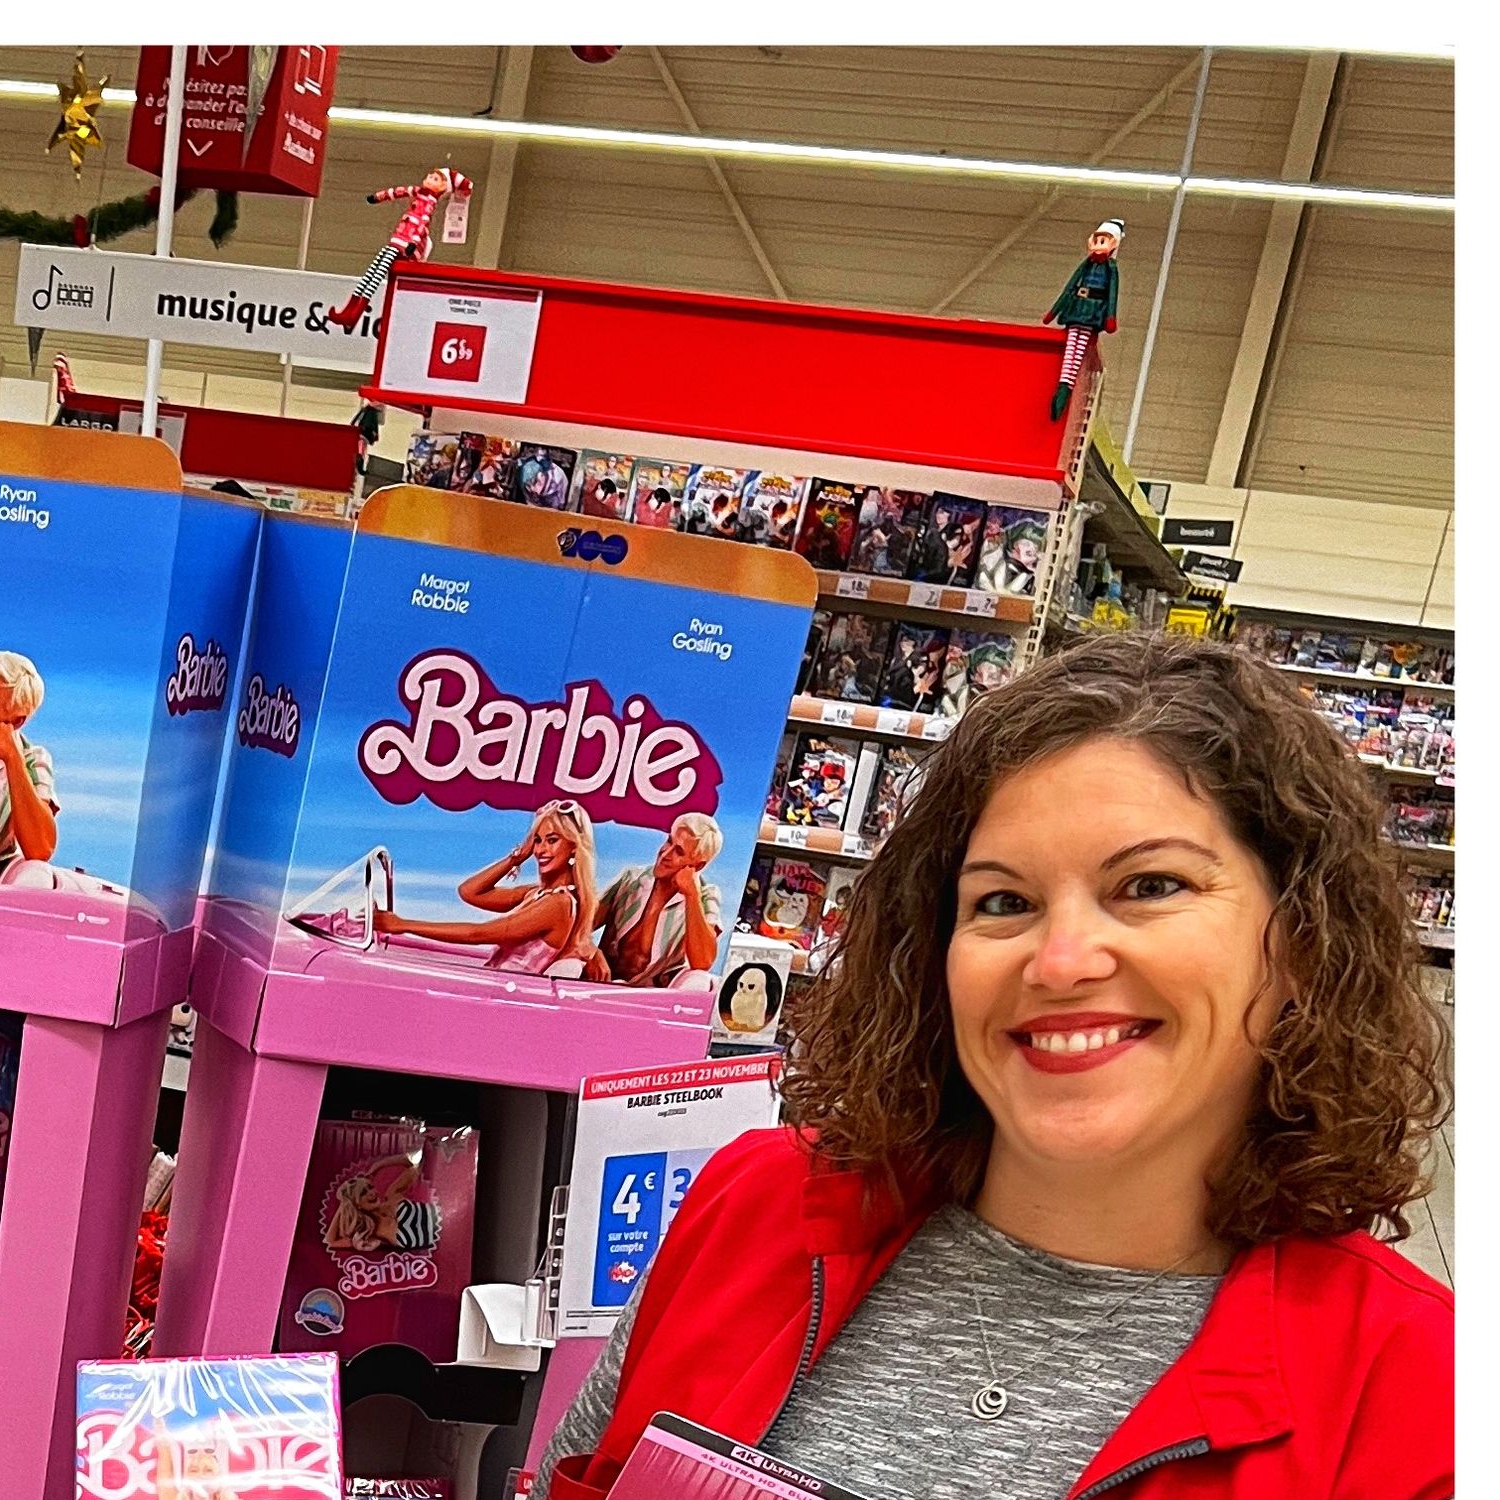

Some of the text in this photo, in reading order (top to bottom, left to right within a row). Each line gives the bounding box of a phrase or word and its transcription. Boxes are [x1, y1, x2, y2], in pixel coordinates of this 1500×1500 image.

[156, 290, 297, 331] musique
[305, 302, 330, 334] &
[0, 484, 37, 504] Ryan
[420, 572, 470, 595] Margot
[411, 589, 470, 614] Robbie
[689, 617, 724, 637] Ryan
[672, 632, 733, 661] Gosling
[167, 634, 228, 702] Barbie
[240, 675, 299, 743] Barbie
[364, 654, 700, 807] Barbie
[591, 1067, 712, 1094] UNIQUEMENT LES 22 ET 23
[627, 1087, 724, 1109] BARBIE STEELBOOK
[608, 1230, 648, 1242] sur votre
[610, 1243, 644, 1255] compte
[344, 1255, 430, 1294] Barbie
[720, 1461, 755, 1480] ULTRA
